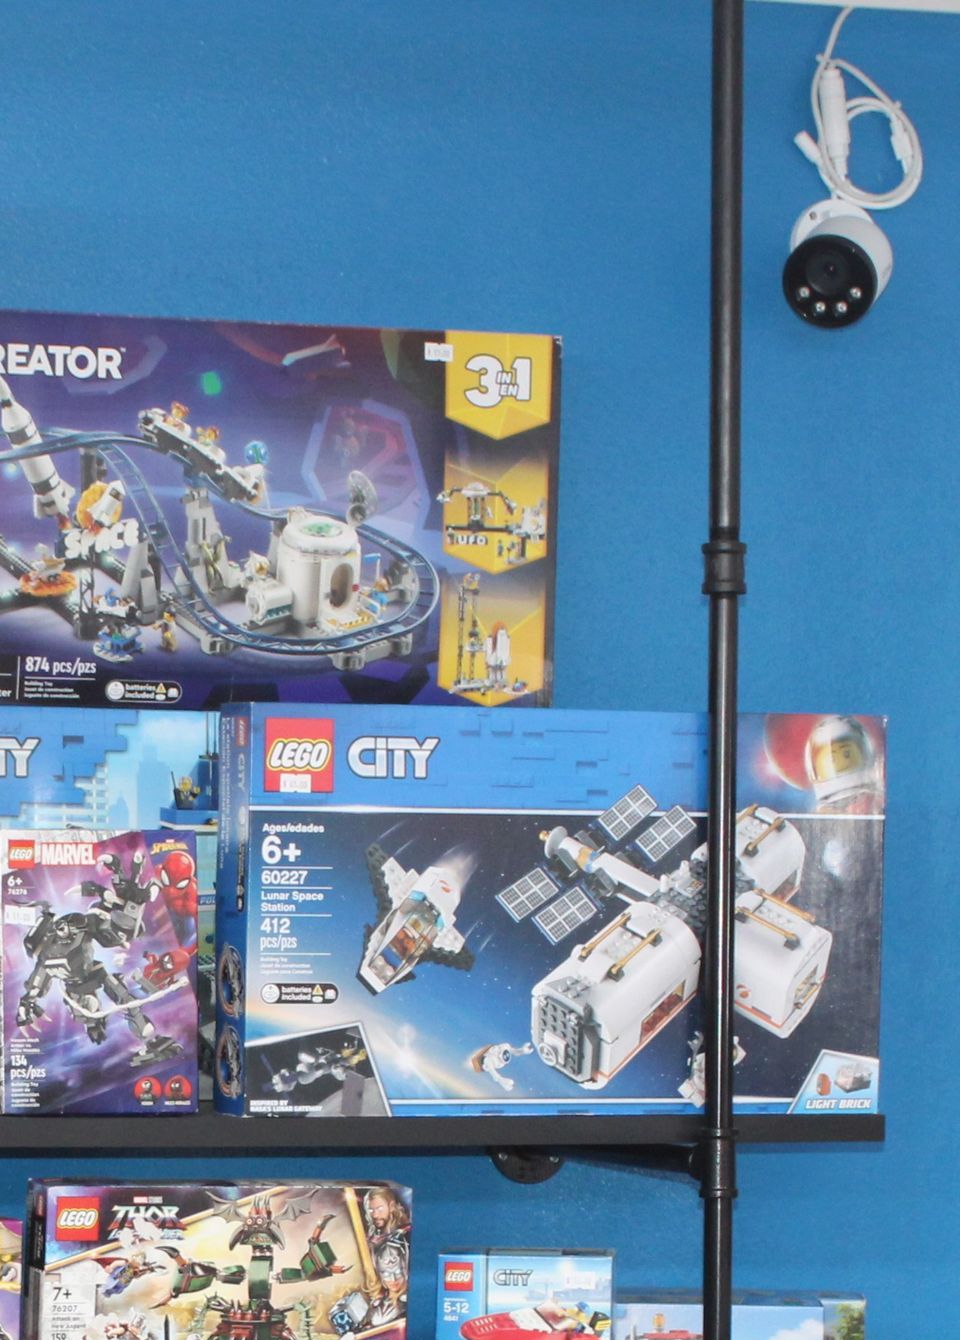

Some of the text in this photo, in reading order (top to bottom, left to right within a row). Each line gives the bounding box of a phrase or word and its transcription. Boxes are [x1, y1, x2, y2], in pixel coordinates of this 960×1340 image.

[25, 656, 96, 675] 874 pcs/pzs
[126, 683, 156, 691] batteries
[125, 691, 154, 699] included
[269, 736, 440, 779] LEGO CITY
[262, 823, 324, 833] Ages/edades
[9, 842, 95, 865] LEGO MARVEL
[262, 836, 301, 864] 6+
[8, 877, 23, 887] 6+
[262, 871, 308, 885] 60227
[261, 891, 323, 902] Lunar Space
[261, 903, 296, 912] Station
[260, 919, 290, 933] 412
[260, 936, 297, 950] pcs/pzs
[11, 1055, 27, 1066] 134
[10, 1066, 46, 1080] pcs/pzs
[805, 1099, 872, 1109] LIGHT BRICK
[58, 1205, 187, 1230] LEGO THOR
[445, 1269, 533, 1286] LEGO CITY
[52, 1287, 72, 1301] 7+
[52, 1305, 77, 1313] 76207
[444, 1303, 469, 1312] 5-12
